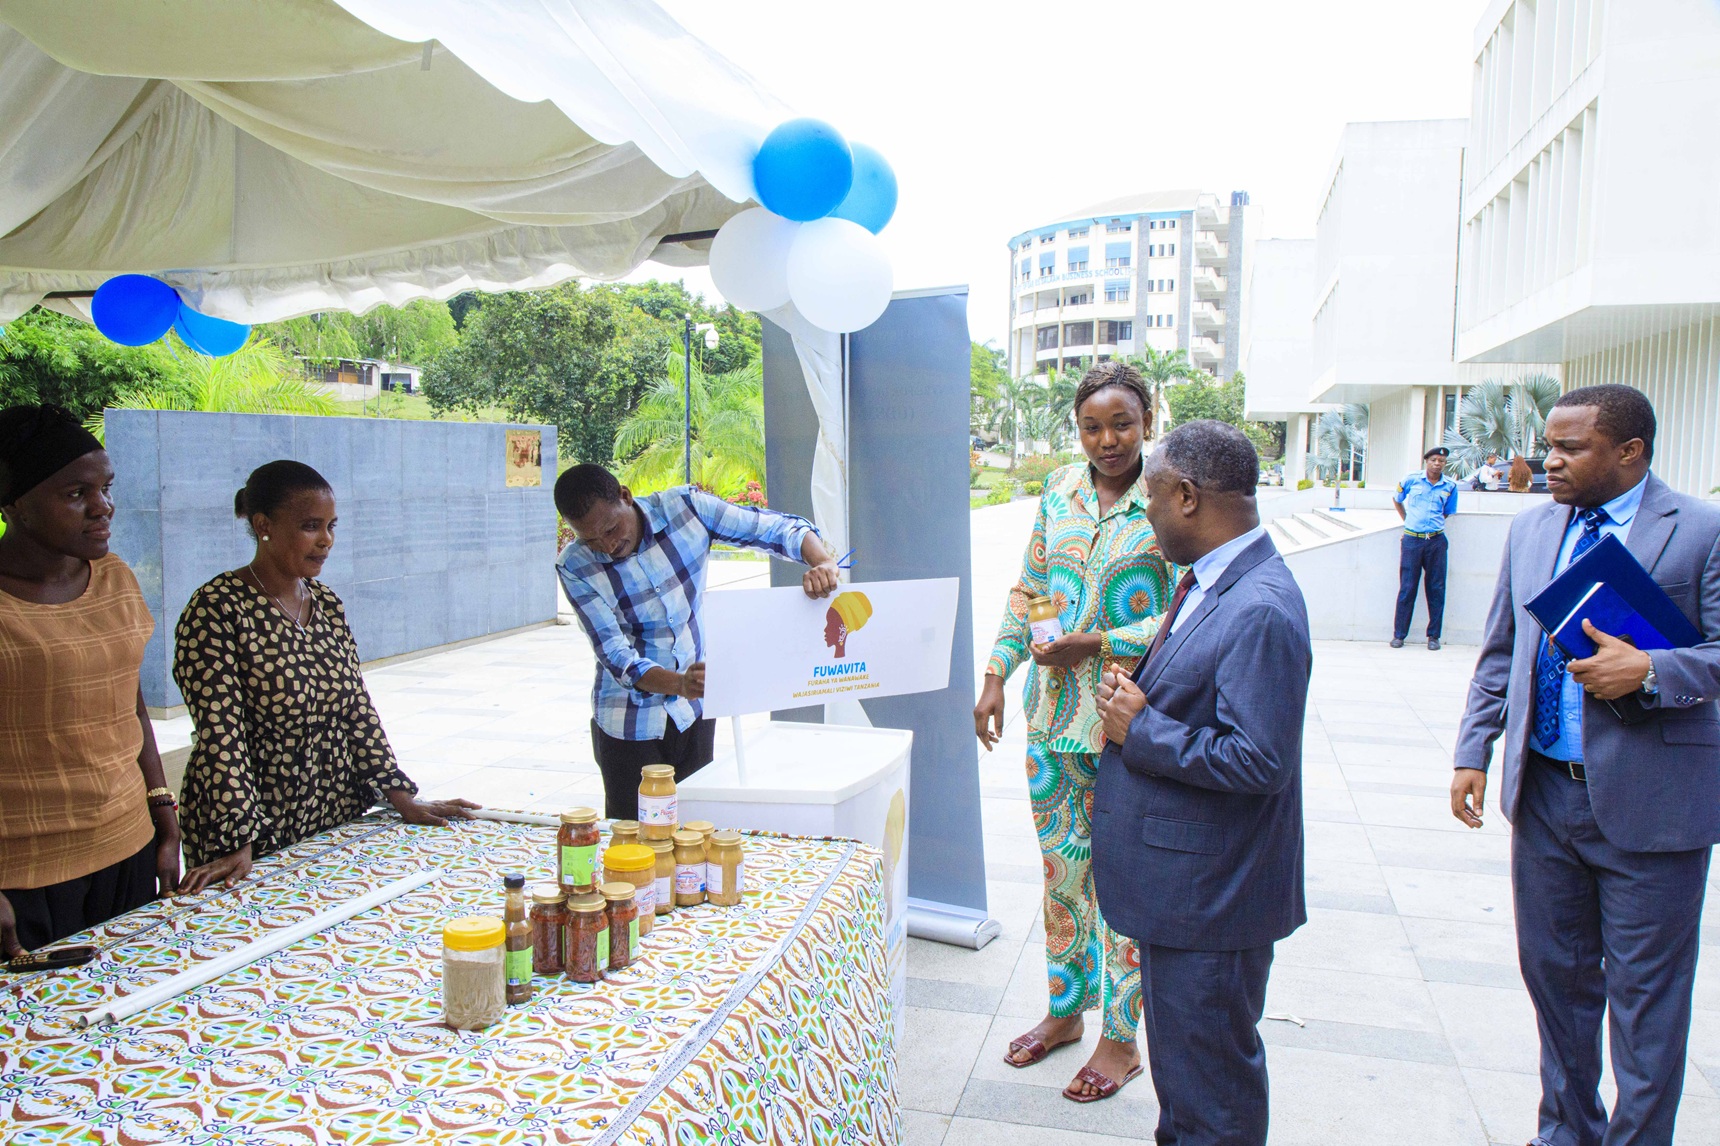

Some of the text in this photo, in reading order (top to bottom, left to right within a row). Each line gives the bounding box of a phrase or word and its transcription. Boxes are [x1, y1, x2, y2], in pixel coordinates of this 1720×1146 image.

[1062, 270, 1093, 281] BUSINESS
[1095, 267, 1124, 277] SCHOOL
[814, 662, 866, 677] FUWAVITA
[807, 679, 829, 687] FURAHA
[839, 674, 869, 683] WANAWAKE
[792, 682, 879, 698] WAJASIRIAMALI VIZIWI TANZANIA
